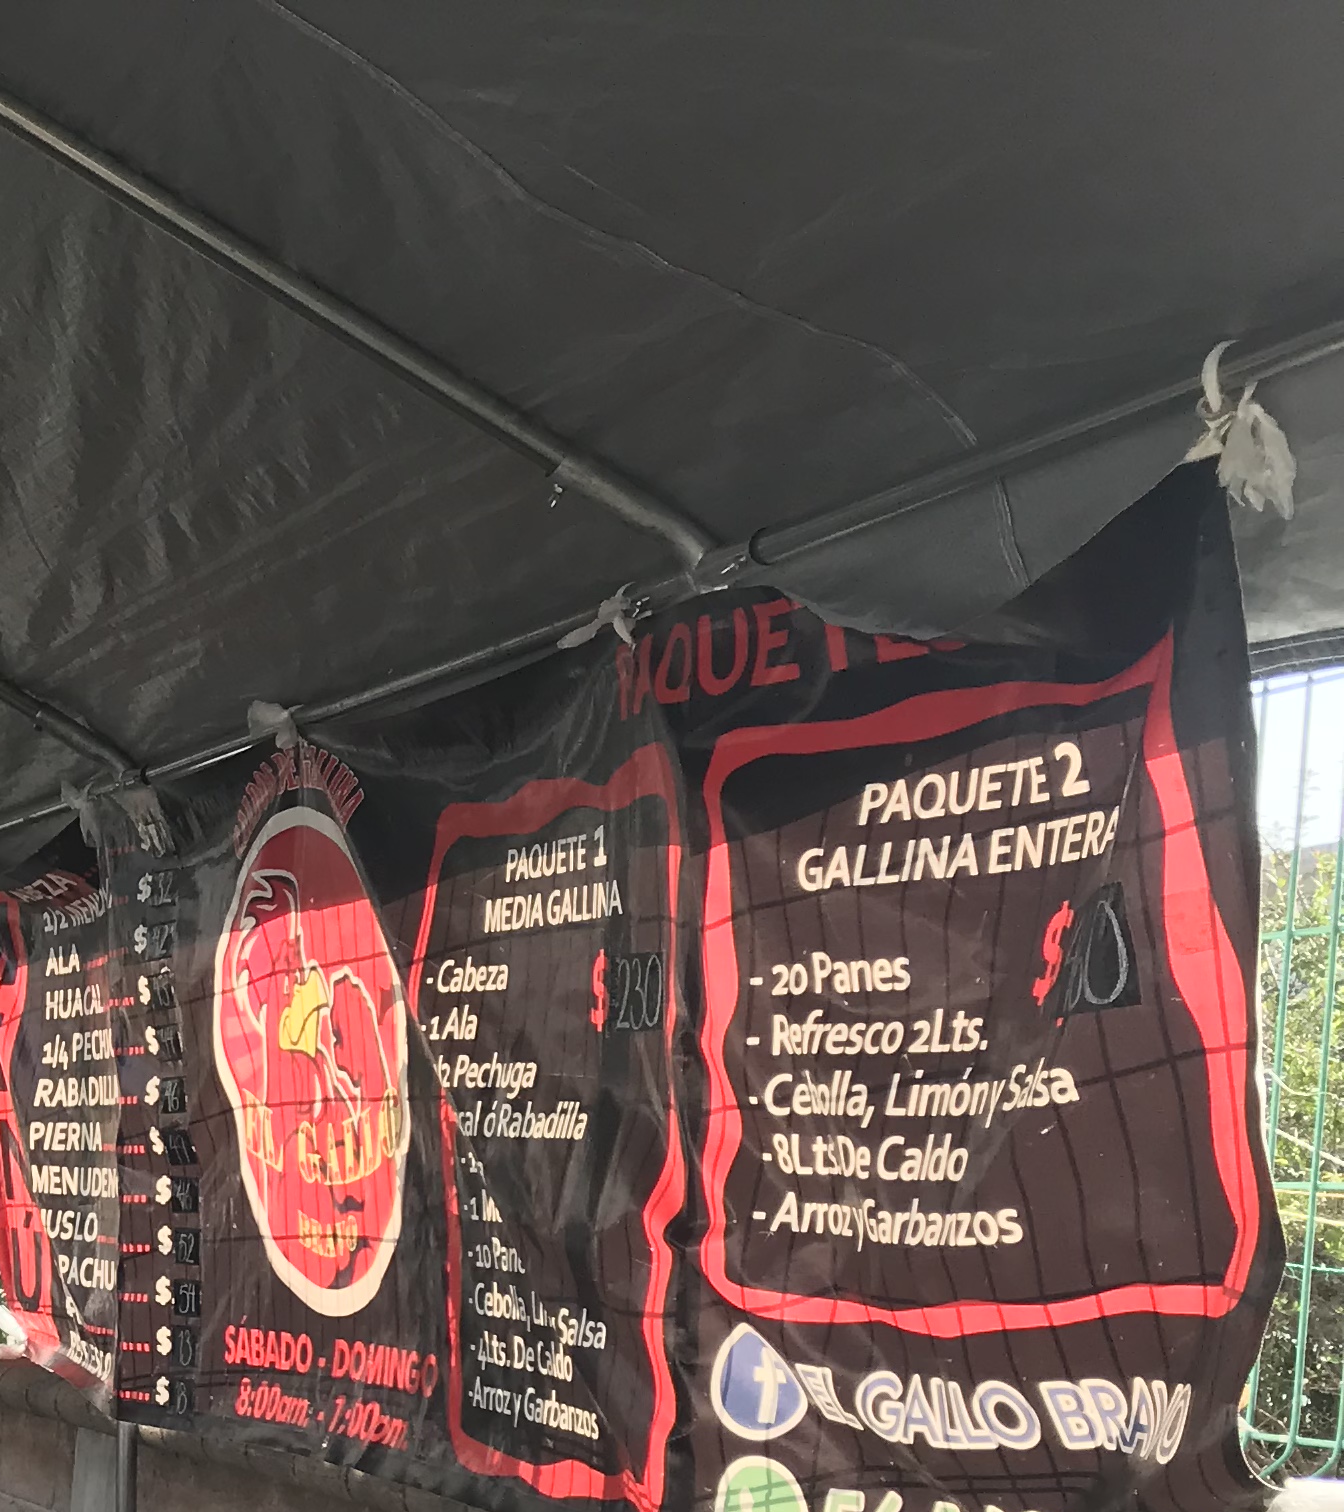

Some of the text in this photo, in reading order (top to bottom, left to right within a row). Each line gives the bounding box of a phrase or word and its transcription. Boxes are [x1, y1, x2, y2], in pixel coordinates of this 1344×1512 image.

[857, 741, 1091, 827] PAQUETE 2
[505, 824, 608, 883] PAQUETE 1
[797, 803, 1121, 893] GALLINA ENTERA
[484, 879, 624, 934] MEDIA GALLINA
[44, 942, 81, 978] ALA
[437, 955, 510, 994] Cabeza
[771, 950, 912, 997] 20 Panes
[45, 983, 105, 1021] HUACAL
[441, 1003, 479, 1041] Ala
[41, 1032, 70, 1071] 1/4
[771, 1010, 905, 1058] Refresco
[452, 1051, 538, 1100] Pechuga
[29, 1120, 103, 1152] PIERNA
[242, 1086, 399, 1187] EL GALLO
[497, 1100, 589, 1141] Rabadilla
[876, 1132, 970, 1183] Caldo
[297, 1208, 358, 1259] BRAVO
[770, 1190, 855, 1238] Arroz
[861, 1198, 1024, 1247] Garbanzos
[475, 1243, 492, 1269] 10
[557, 1306, 608, 1351] Salsa
[224, 1314, 314, 1375] SÁBADO
[330, 1338, 440, 1399] DOMINGO
[512, 1334, 536, 1373] De
[536, 1339, 574, 1383] Caldo
[471, 1375, 600, 1441] Arroz y Garbanzos
[855, 1372, 1042, 1451] GALLO
[1036, 1376, 1193, 1466] BRAVO
